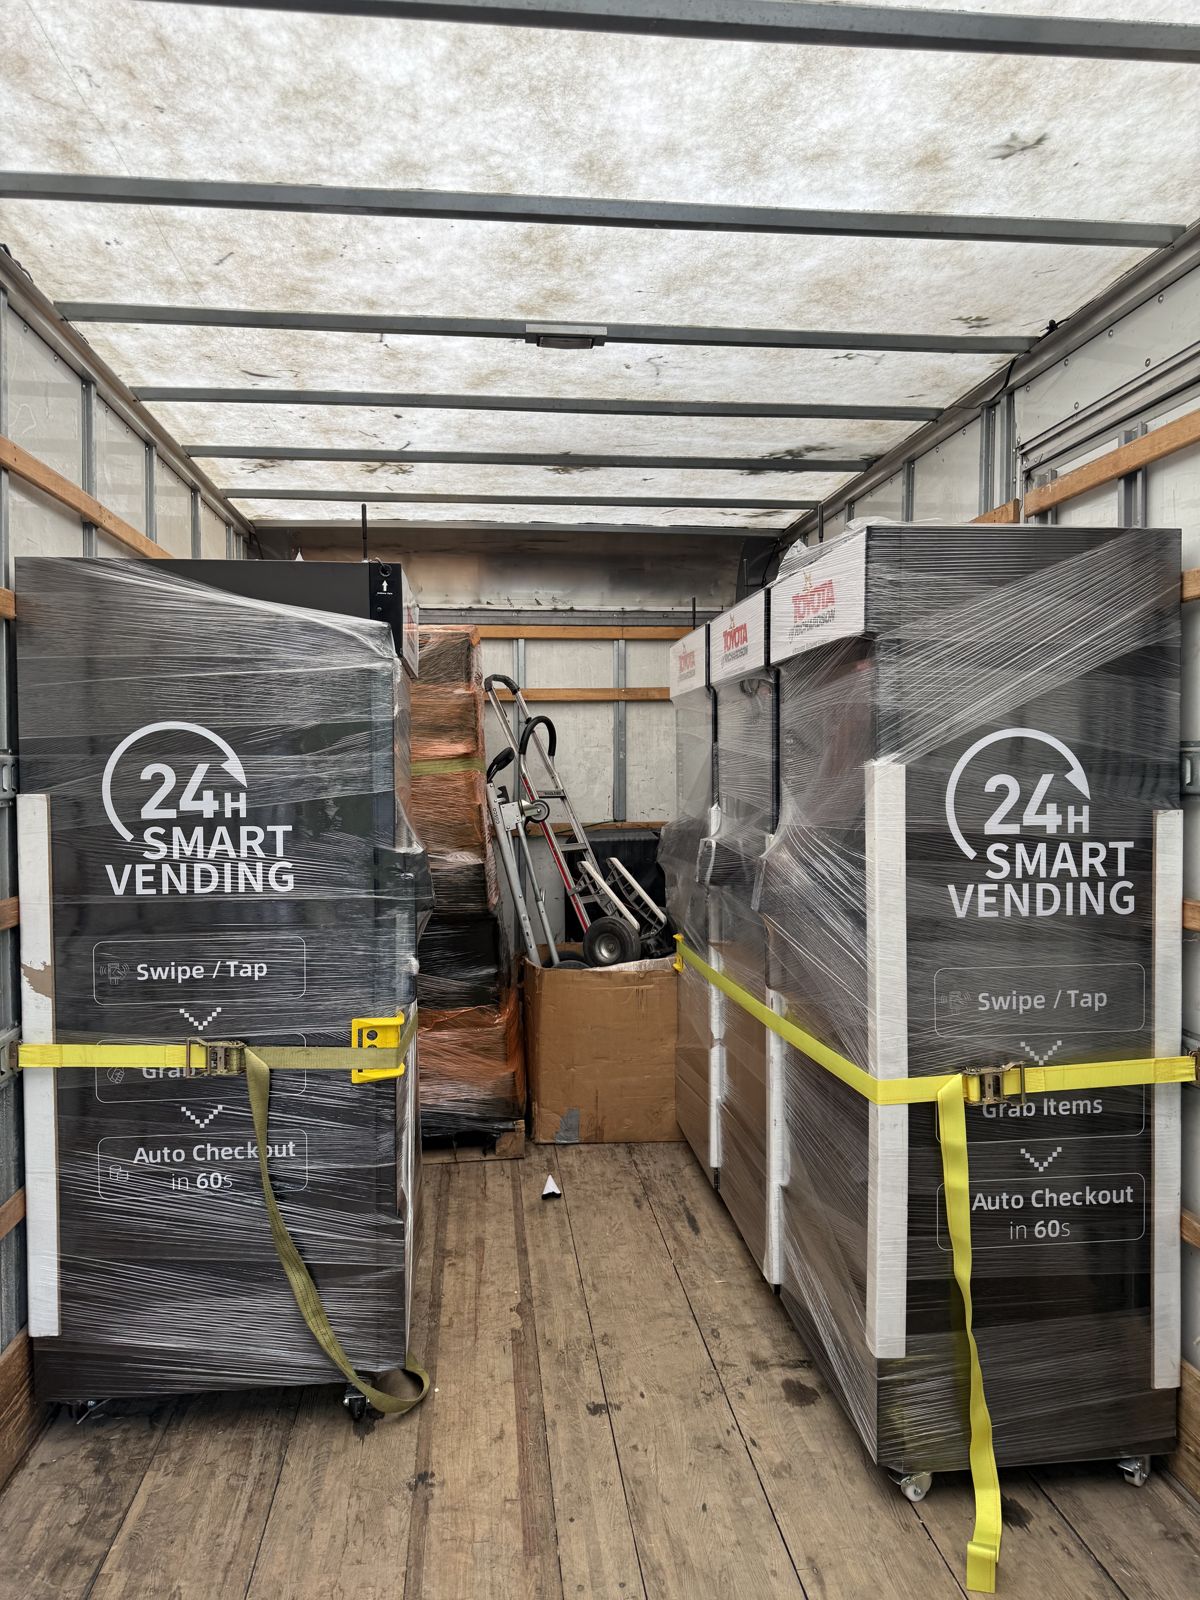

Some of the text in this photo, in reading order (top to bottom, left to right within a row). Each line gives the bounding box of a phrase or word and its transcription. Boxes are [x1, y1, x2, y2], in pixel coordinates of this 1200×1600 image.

[792, 579, 835, 623] TOYOTA
[722, 623, 748, 652] TOYOTA
[139, 763, 247, 819] 24H
[984, 773, 1090, 834] 24H
[142, 825, 293, 860] SMART
[985, 841, 1134, 879] SMART
[105, 861, 294, 896] VENDING
[948, 880, 1135, 918] VENDING
[136, 960, 268, 983] Swipe / Tap
[977, 989, 1108, 1014] Swipe / Tap
[1043, 1098, 1103, 1116] Items
[133, 1140, 297, 1164] Auto Checkout
[171, 1172, 233, 1190] in 60s
[972, 1185, 1134, 1211] Auto Checkout
[1010, 1220, 1071, 1240] in 60s
